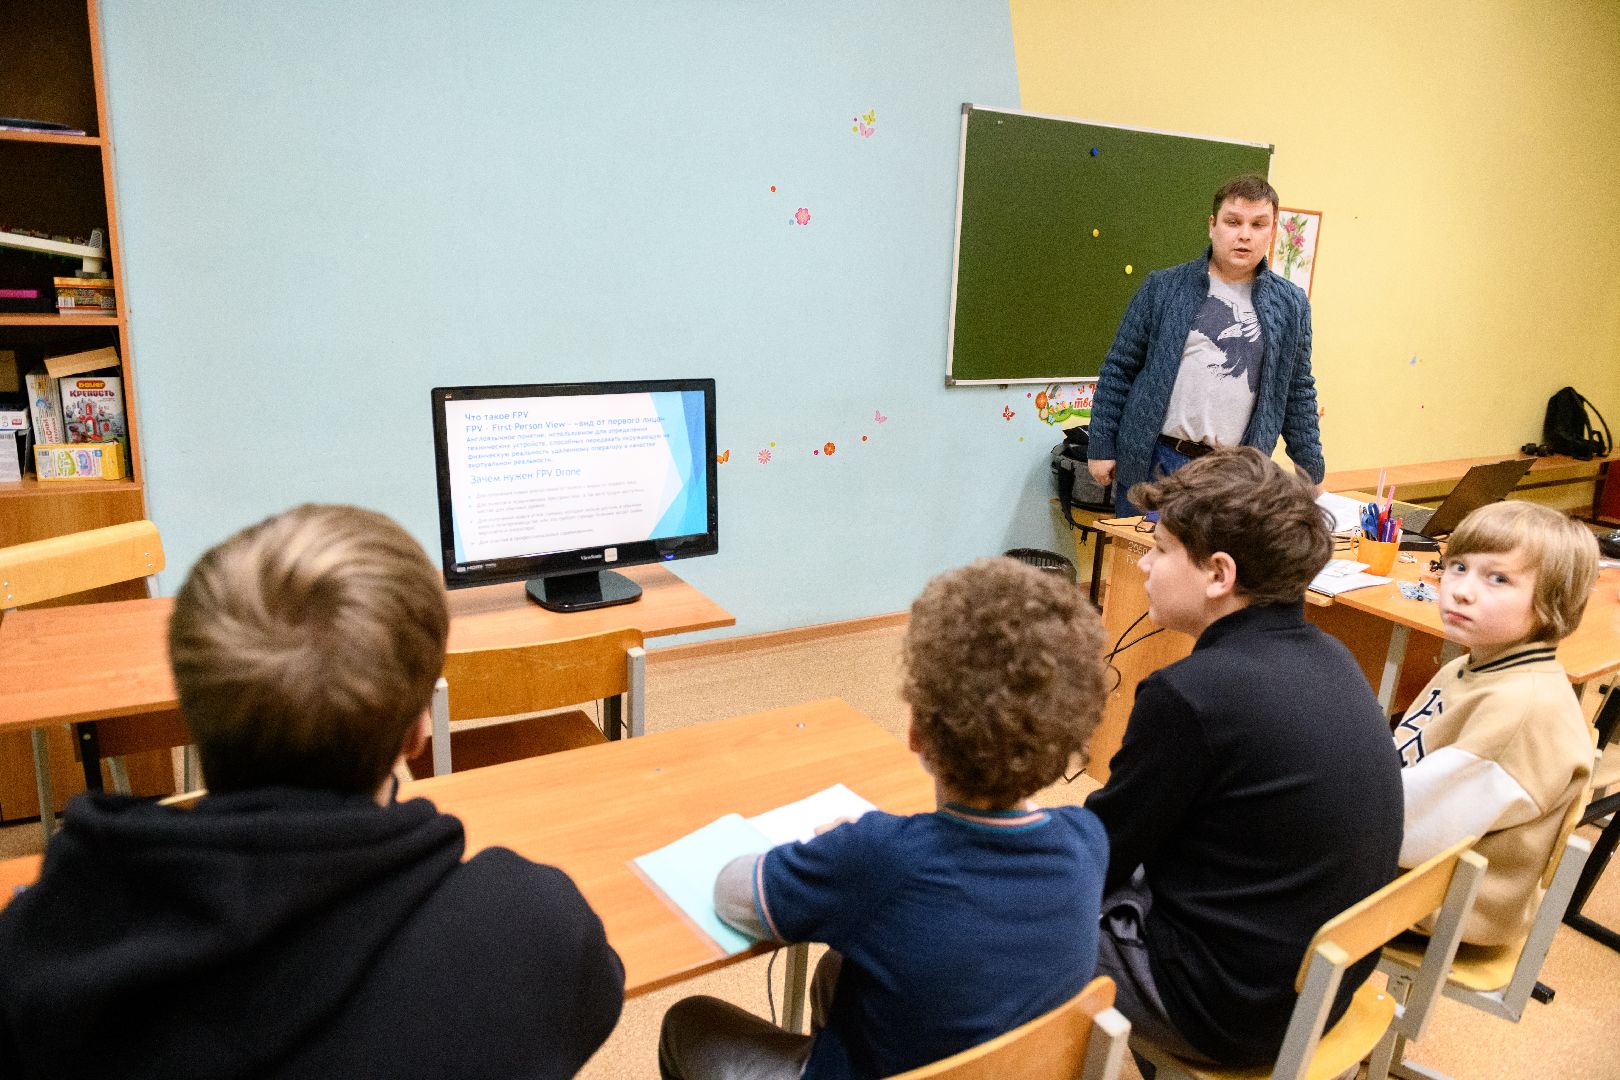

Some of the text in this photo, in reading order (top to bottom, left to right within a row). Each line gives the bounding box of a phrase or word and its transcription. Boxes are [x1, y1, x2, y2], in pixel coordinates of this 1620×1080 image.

[465, 411, 529, 421] Что такое FPV
[466, 424, 483, 432] FPV
[492, 423, 513, 431] First
[514, 422, 543, 431] Person
[545, 421, 566, 429] View
[608, 417, 640, 426] первого
[471, 467, 581, 485] Зачем нужен FPV Drone
